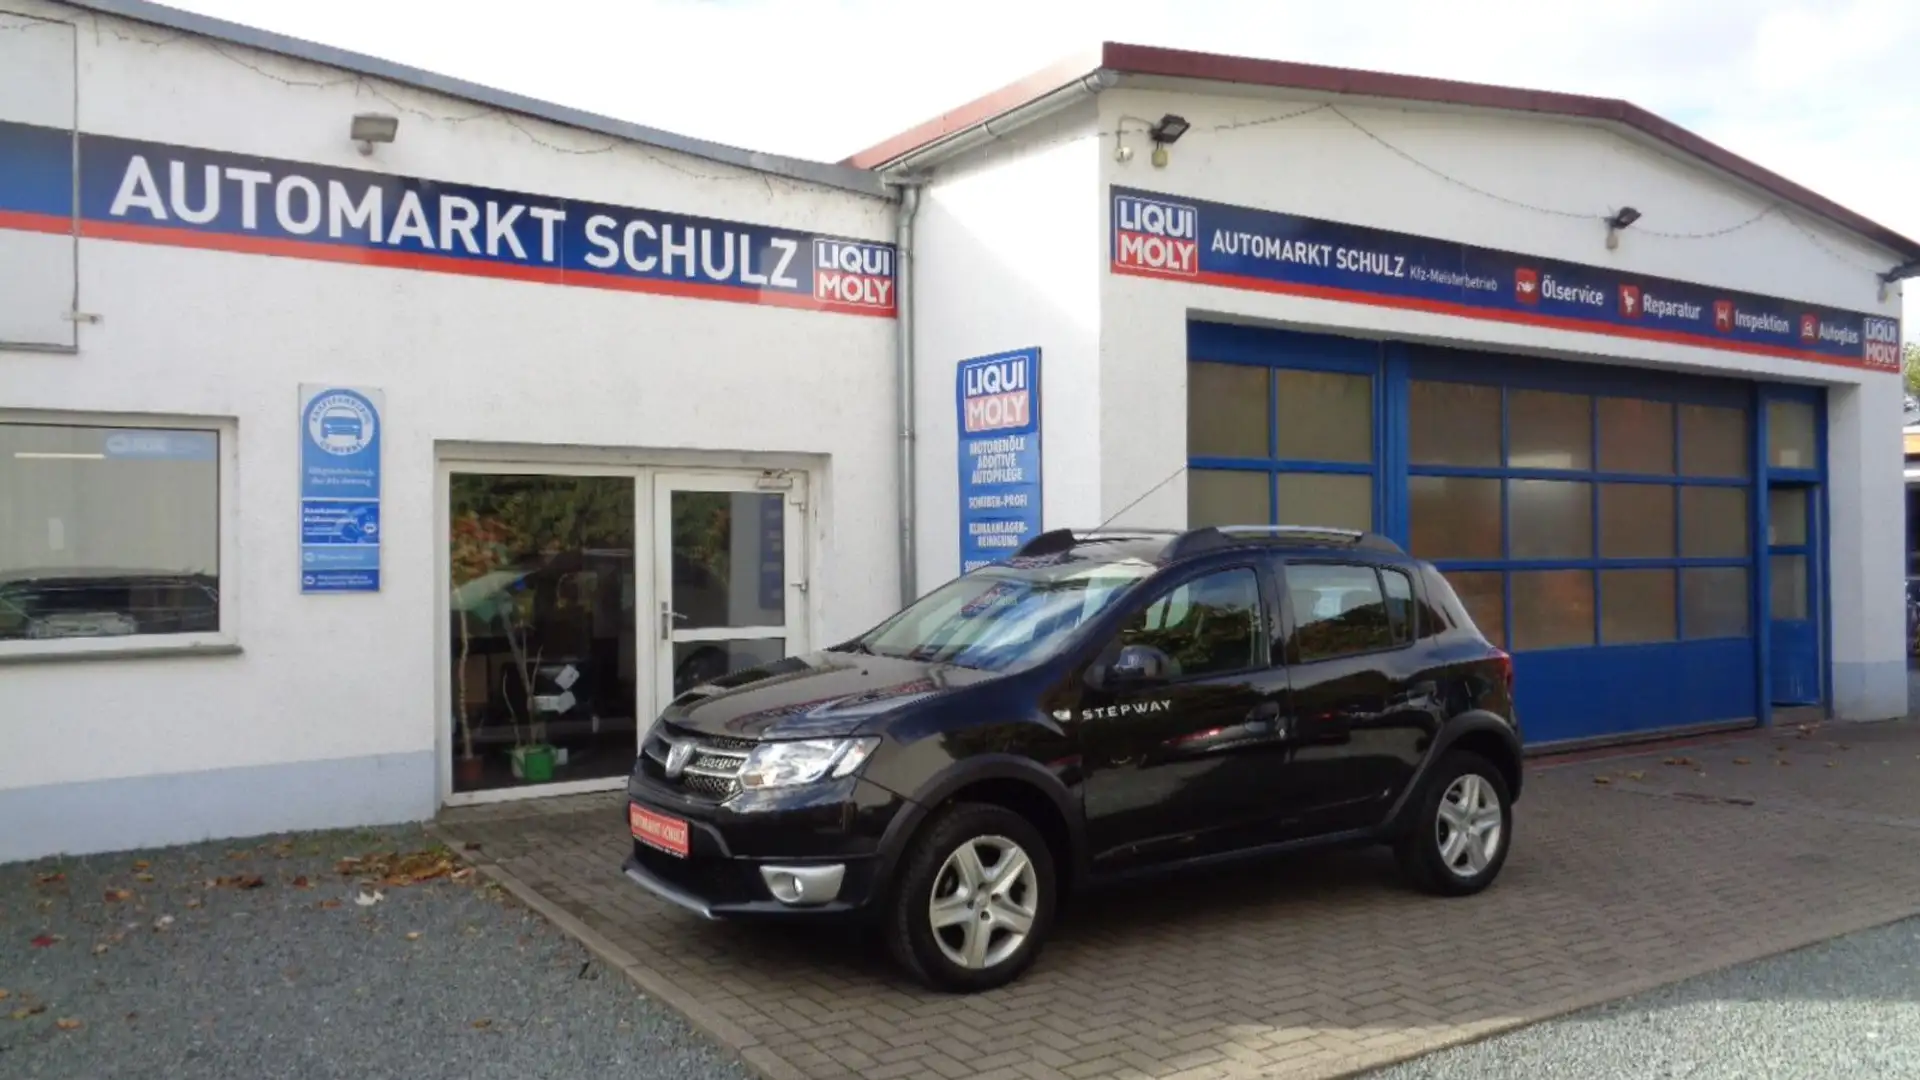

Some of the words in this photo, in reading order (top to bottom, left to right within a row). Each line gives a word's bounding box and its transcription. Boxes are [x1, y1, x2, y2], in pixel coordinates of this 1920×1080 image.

[110, 155, 566, 262] AUTOMARKT
[584, 214, 798, 288] SCHULZ
[1120, 201, 1193, 238] LIQUI
[818, 243, 890, 276] LIQUI
[1120, 234, 1195, 270] MOLY
[1211, 229, 1332, 267] AUTOMARKT
[1336, 247, 1405, 278] SCHULZ
[1409, 265, 1498, 292] Kfz-Meisterbetrieb
[819, 273, 893, 304] MOLY
[1541, 274, 1604, 306] Ölservice
[1642, 293, 1702, 321] Reparatur
[1735, 308, 1790, 335] Inspektion
[1818, 322, 1860, 346] Autoglas
[1865, 320, 1897, 343] LIQUI
[1866, 342, 1897, 365] MOLY
[967, 360, 1025, 396] LIQUI
[967, 395, 1025, 428] MOLY
[971, 468, 1022, 485] AUTOPFLEGE
[977, 453, 1017, 469] ADDITIVE
[1082, 699, 1171, 720] STEPWAY
